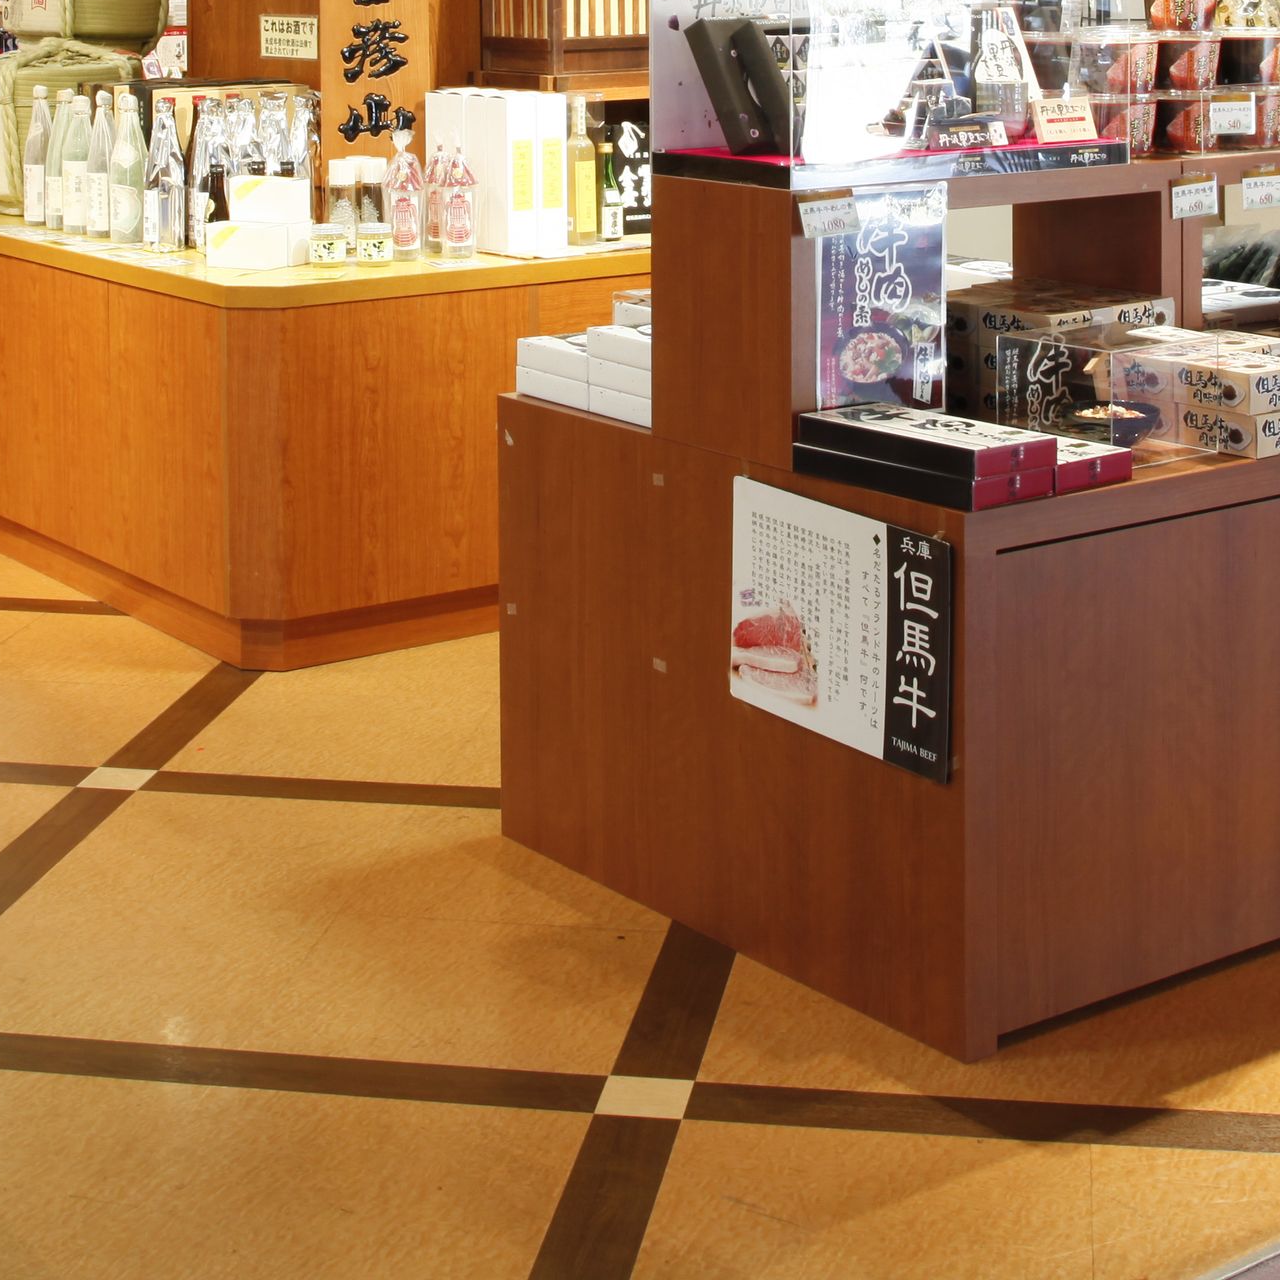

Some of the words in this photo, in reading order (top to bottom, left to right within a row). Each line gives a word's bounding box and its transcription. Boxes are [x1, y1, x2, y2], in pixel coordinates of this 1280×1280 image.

[263, 19, 316, 35] これはお酒です
[1227, 120, 1241, 130] 540
[1188, 201, 1203, 213] 650
[1259, 193, 1273, 205] 650
[823, 219, 846, 232] 1080
[1117, 305, 1153, 325] 但馬牛
[1178, 367, 1222, 390] 但馬牛
[1183, 409, 1226, 434] 但馬牛
[900, 537, 933, 561] 兵庫
[893, 562, 939, 729] 但馬牛
[891, 736, 918, 755] TAJIMA
[919, 746, 937, 763] BEEF
